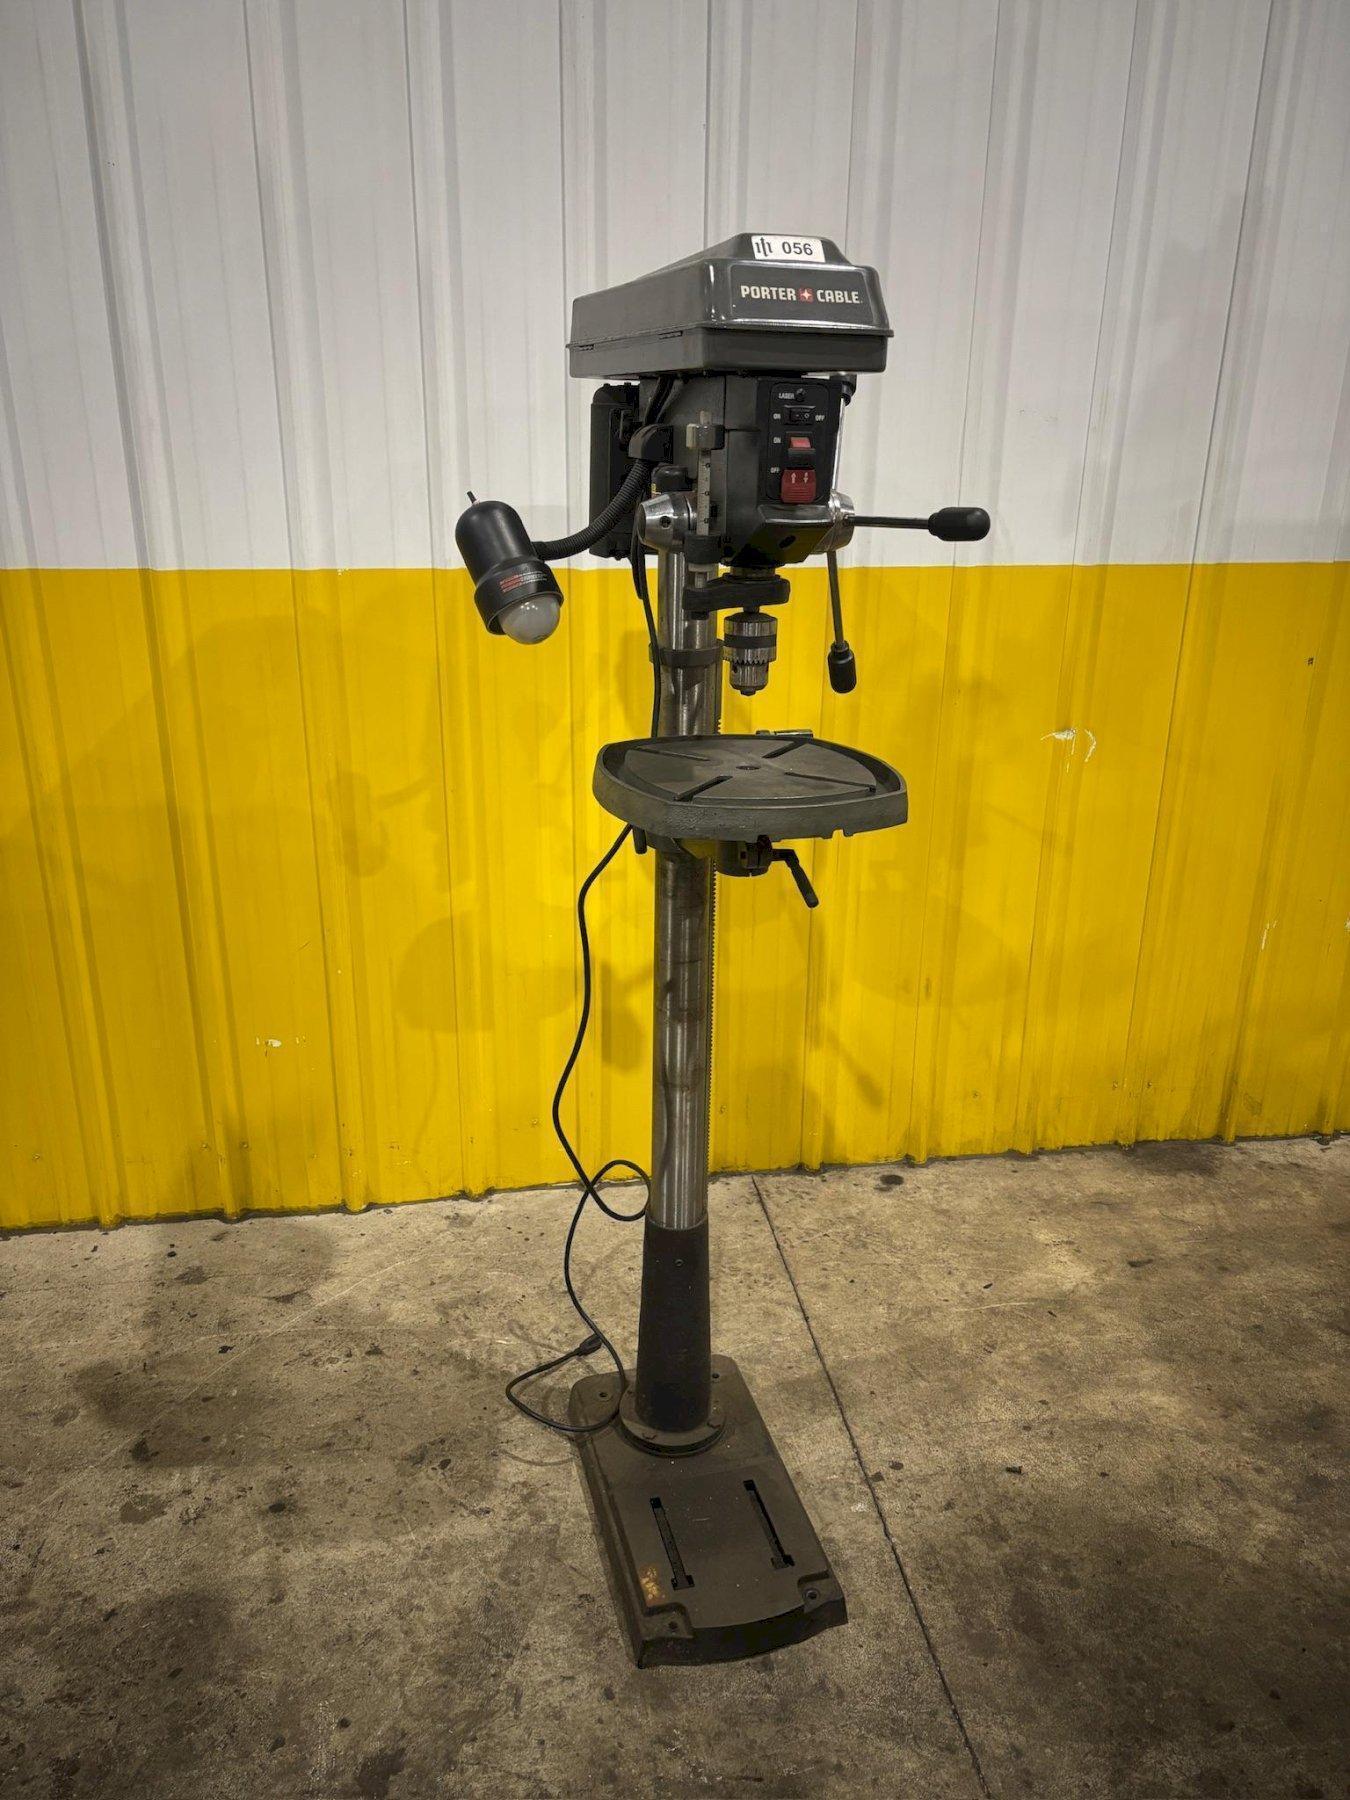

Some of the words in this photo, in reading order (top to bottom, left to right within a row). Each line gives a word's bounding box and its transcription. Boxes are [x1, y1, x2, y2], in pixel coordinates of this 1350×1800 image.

[782, 241, 813, 256] 056
[740, 285, 797, 301] PORTER
[816, 289, 860, 304] CABLE
[779, 392, 795, 400] LASER
[773, 436, 781, 444] ON
